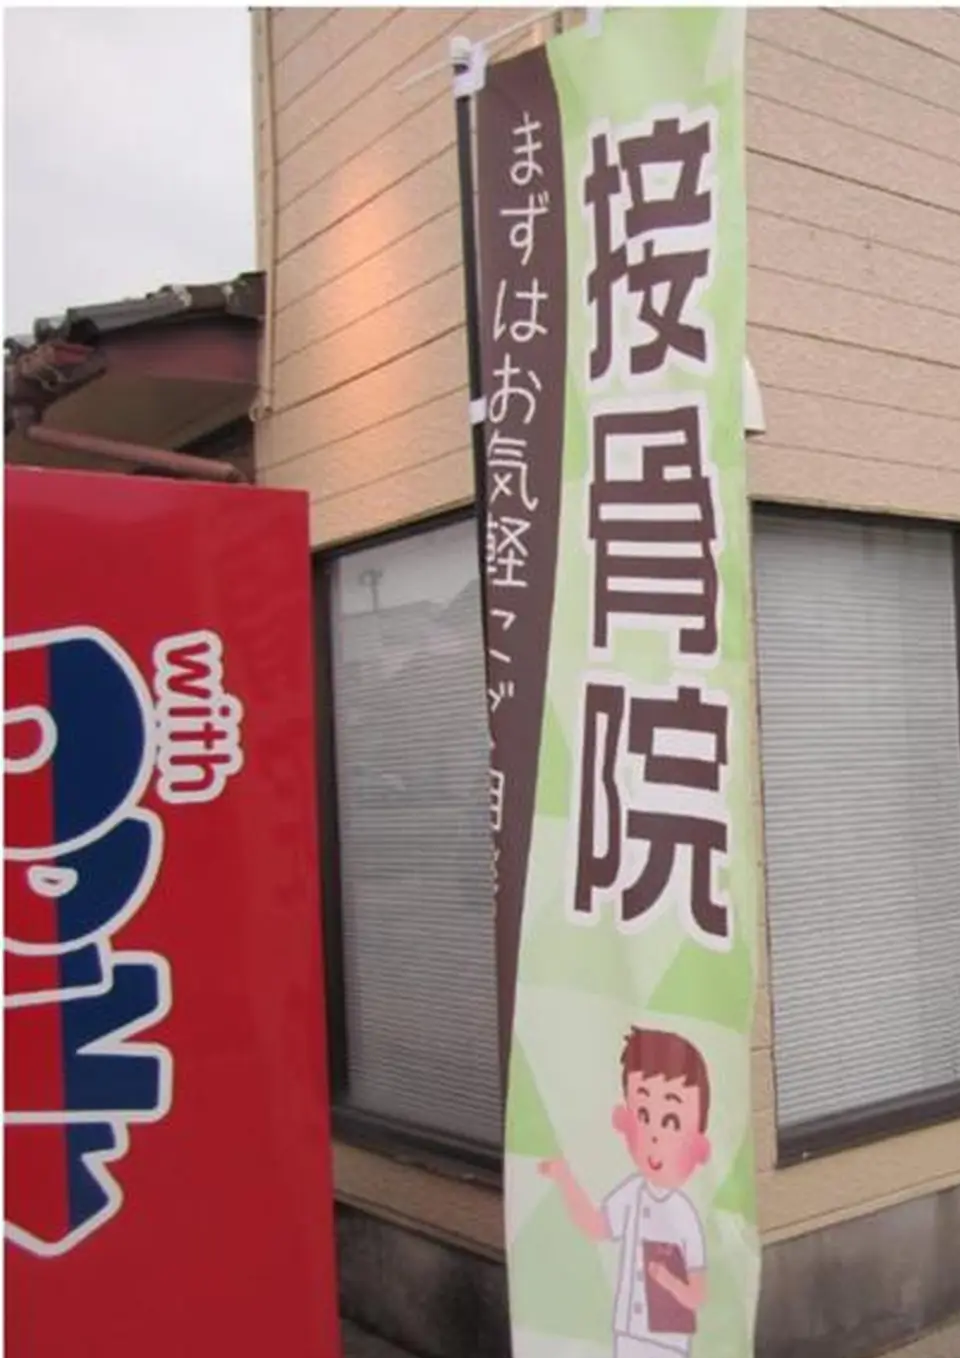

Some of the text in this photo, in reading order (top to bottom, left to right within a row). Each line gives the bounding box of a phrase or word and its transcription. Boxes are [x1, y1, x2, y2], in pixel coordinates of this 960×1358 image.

[156, 635, 242, 802] with
[574, 117, 729, 938] 接骨院
